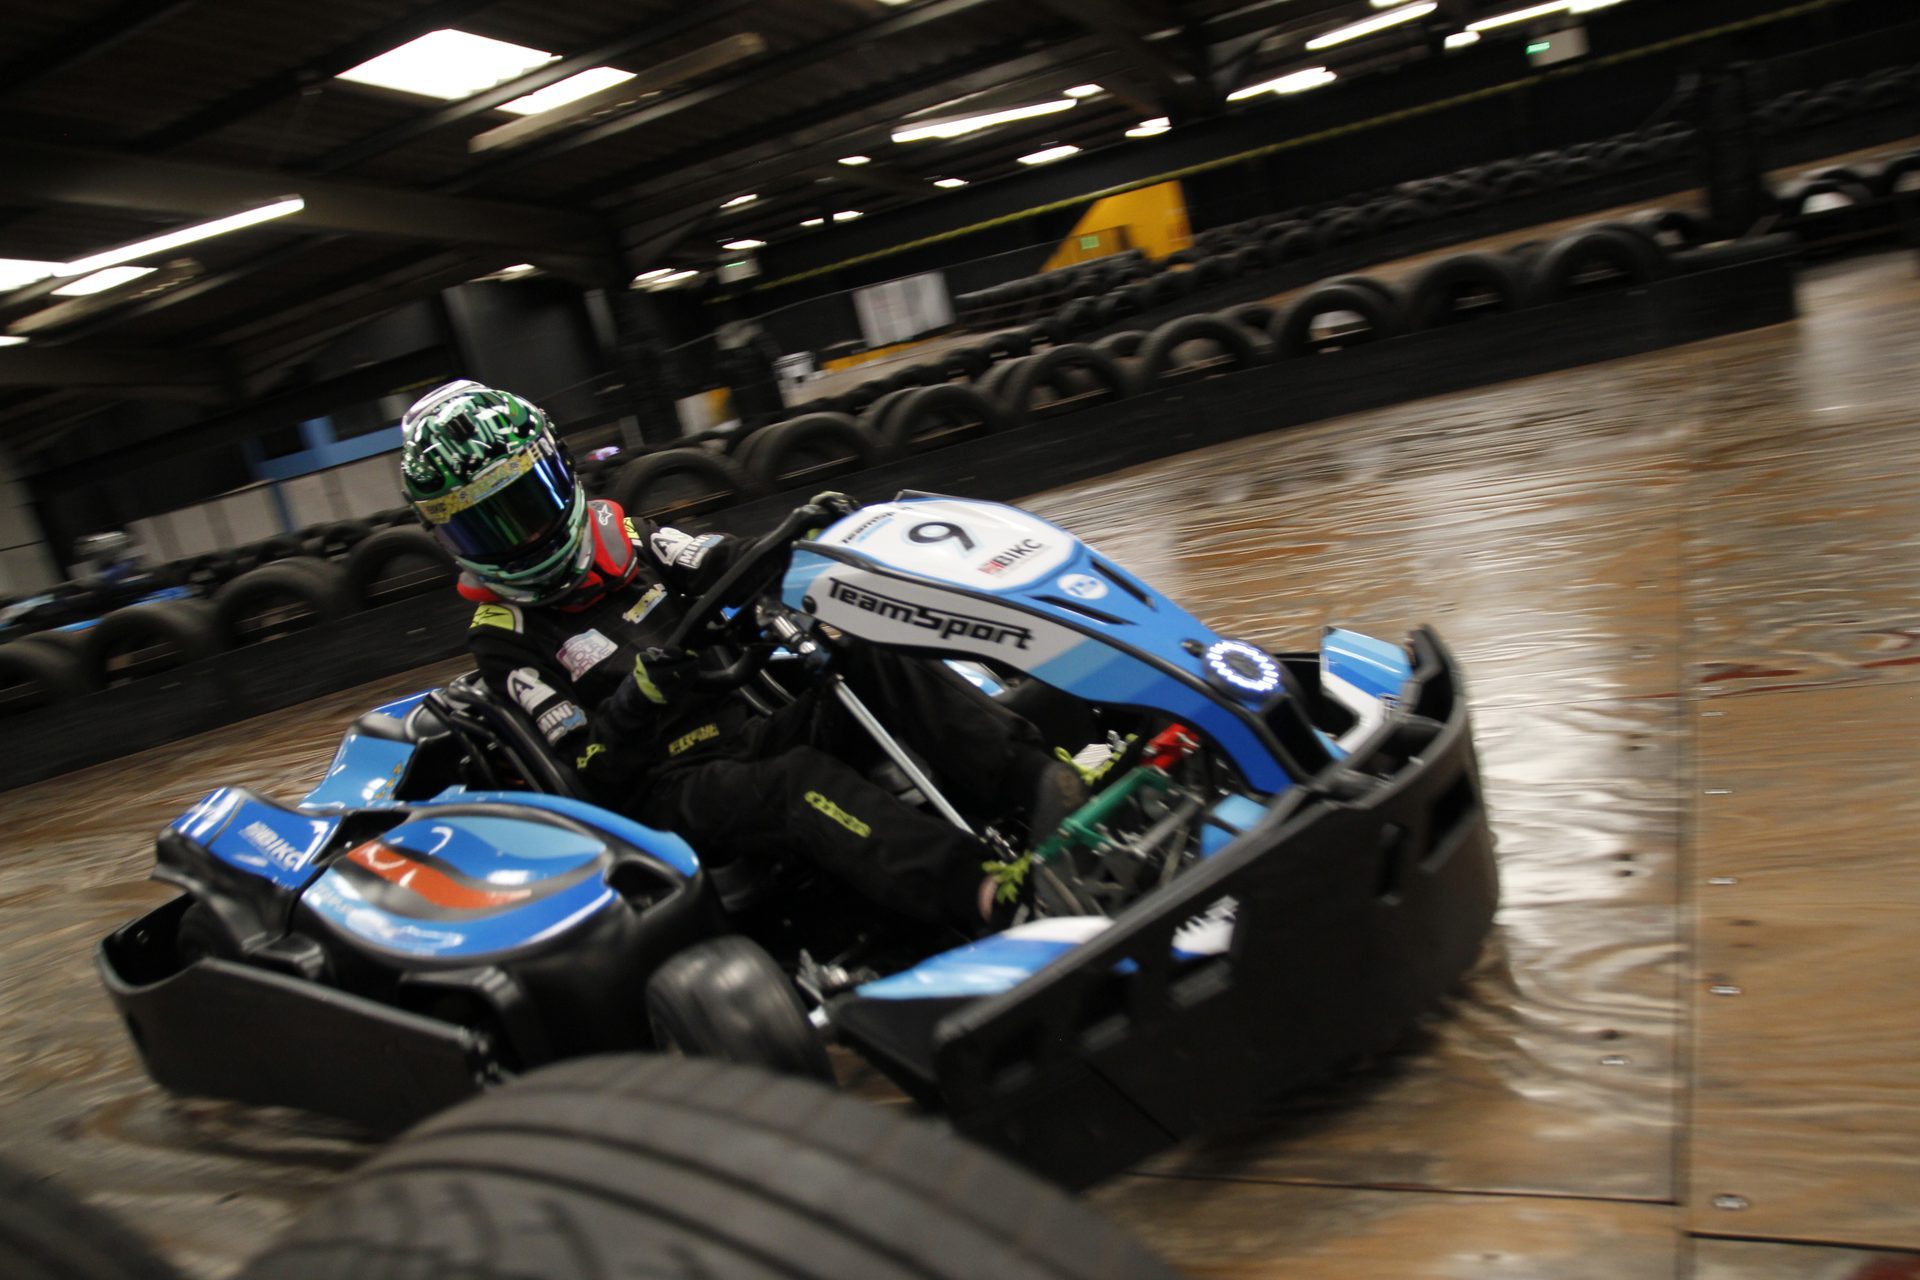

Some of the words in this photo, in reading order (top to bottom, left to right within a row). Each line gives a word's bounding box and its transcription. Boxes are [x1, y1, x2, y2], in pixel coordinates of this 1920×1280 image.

[908, 522, 976, 551] 9
[990, 538, 1043, 567] BIKC
[829, 577, 1034, 650] TeamSport
